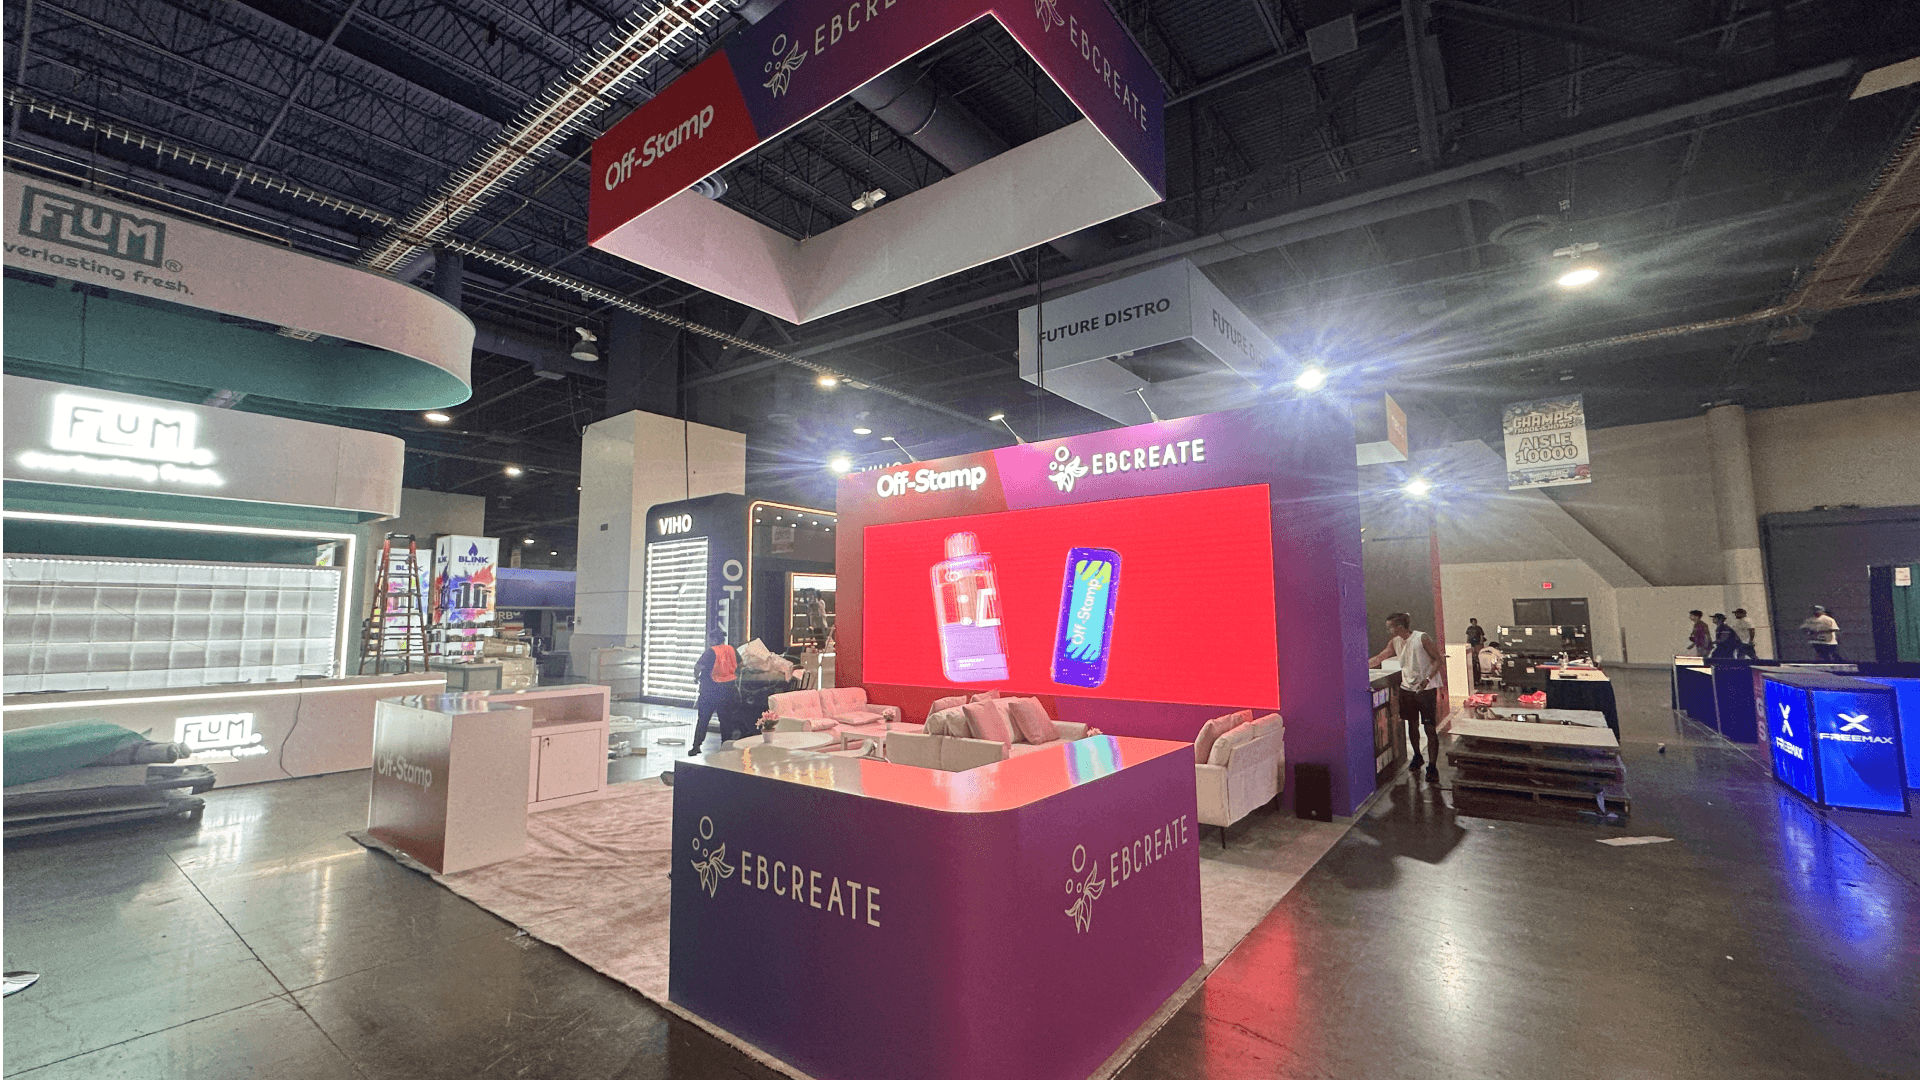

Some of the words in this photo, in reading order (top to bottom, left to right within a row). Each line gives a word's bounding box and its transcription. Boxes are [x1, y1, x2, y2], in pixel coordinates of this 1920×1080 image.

[1069, 14, 1147, 132] EBCREATE
[604, 104, 714, 191] Off-Stamp
[28, 192, 160, 264] FLUM
[133, 270, 195, 296] fresh.
[1039, 316, 1099, 343] FUTURE
[1104, 298, 1171, 327] DISTRO
[1212, 308, 1248, 356] FUTURE
[63, 402, 188, 453] FLUM
[1519, 431, 1573, 450] AISLE
[1091, 438, 1206, 476] EBCREATE
[1515, 444, 1579, 464] 10000
[876, 465, 987, 498] Off-Stamp
[658, 514, 693, 536] VIHO
[458, 555, 490, 564] BLINK
[1071, 578, 1102, 645] Off-Stamp
[180, 717, 248, 745] FLUM
[1818, 732, 1894, 745] FREEMAX
[377, 753, 433, 794] Off-Stamp
[1110, 814, 1188, 889] EBCREATE
[741, 850, 881, 928] EBCREATE
